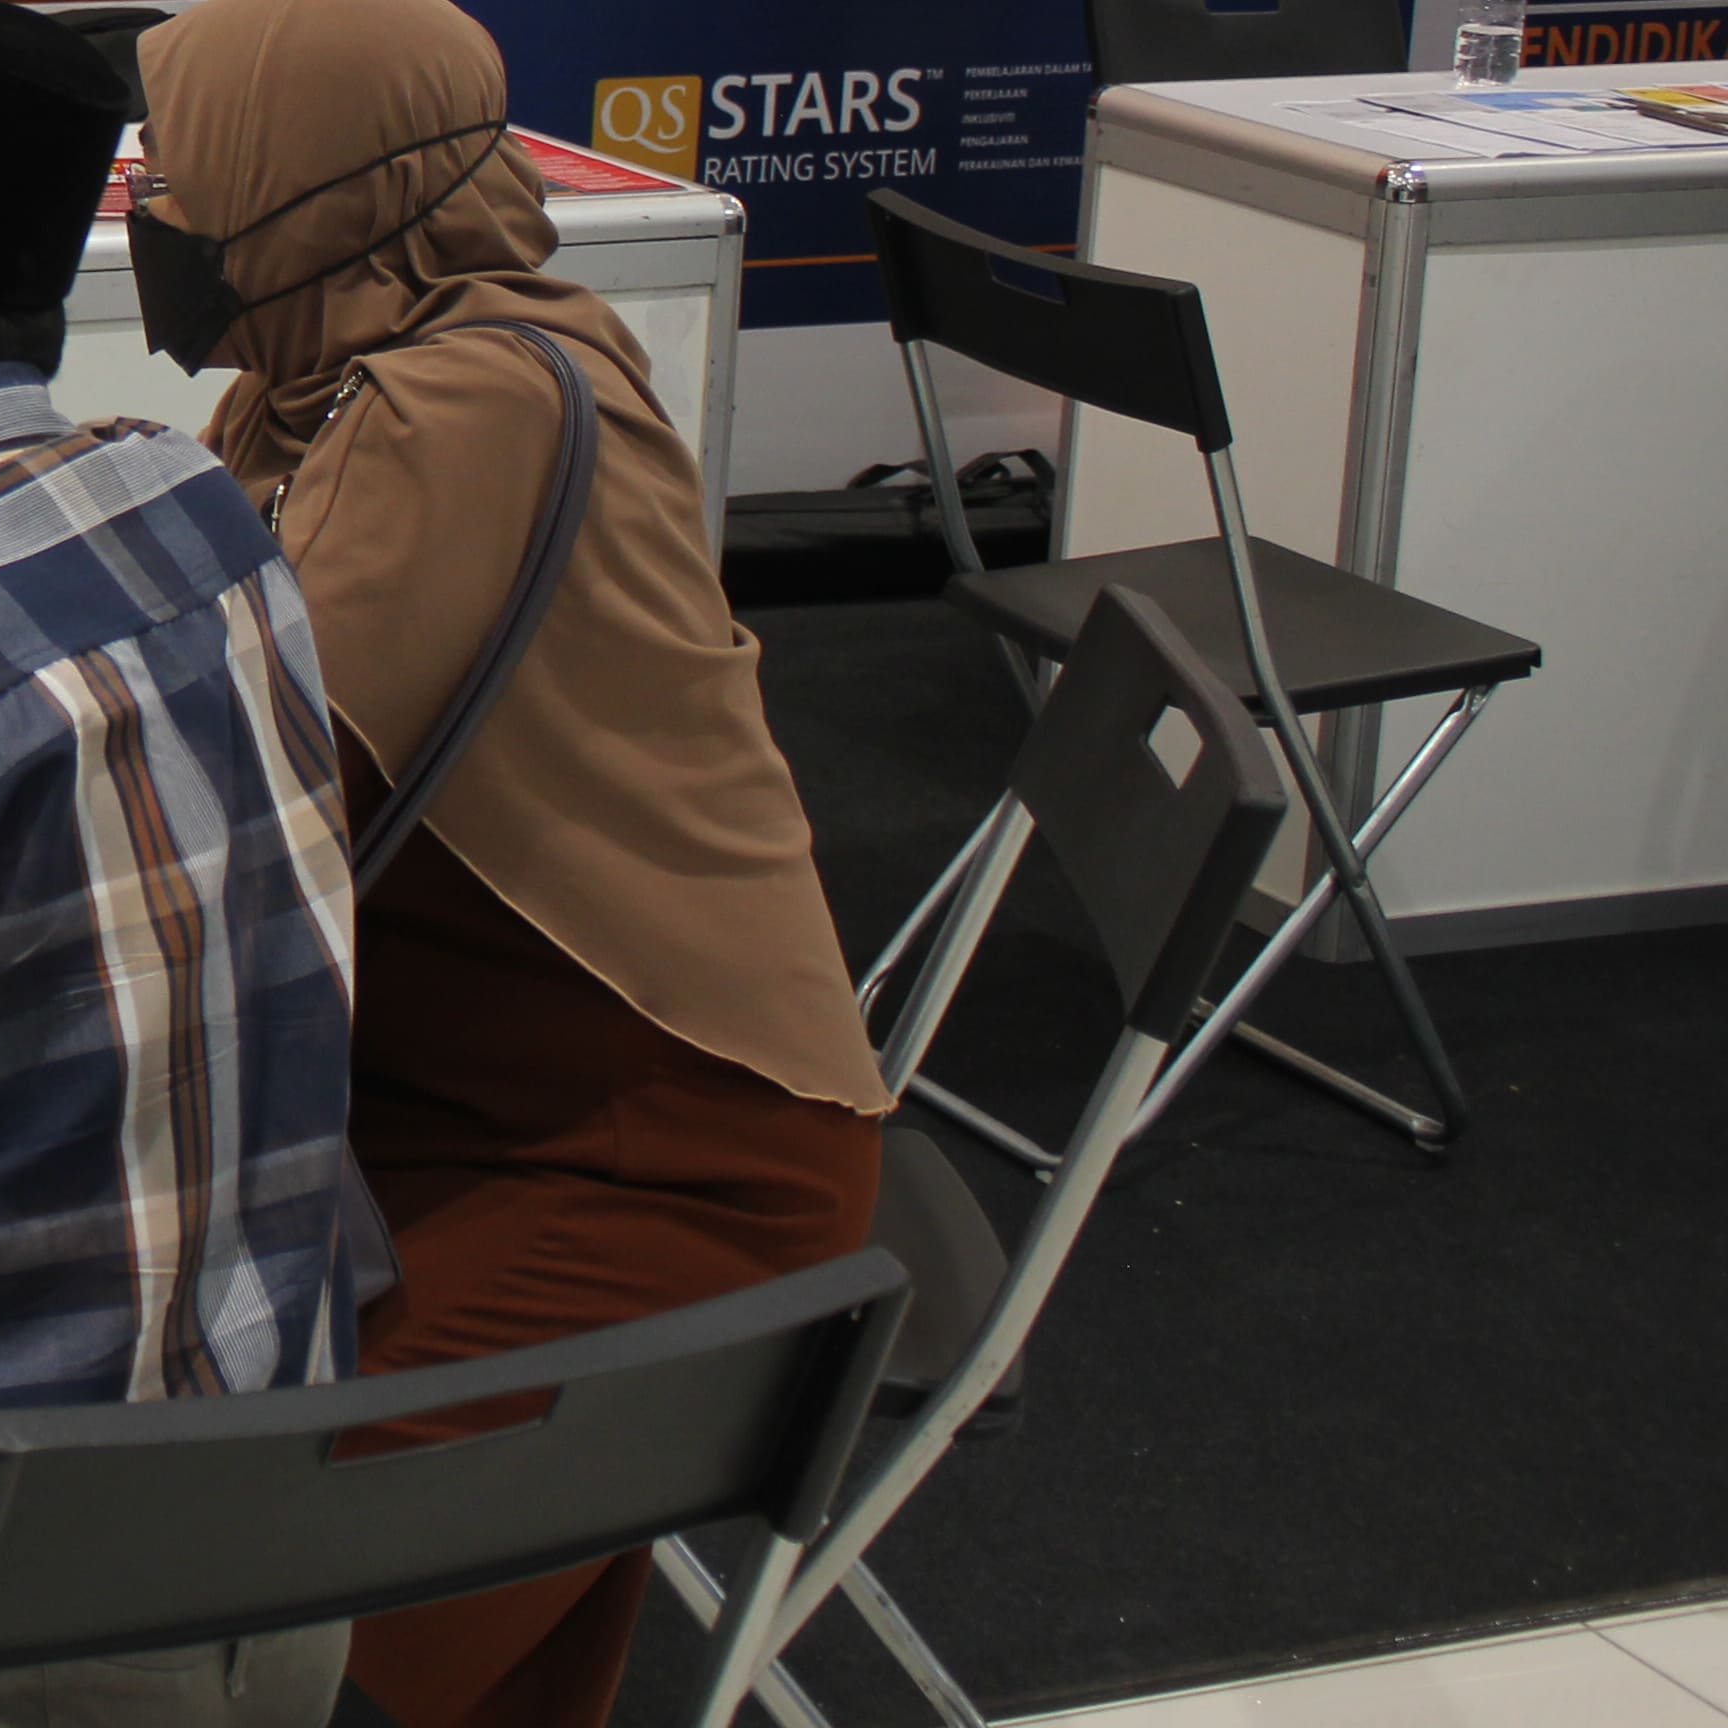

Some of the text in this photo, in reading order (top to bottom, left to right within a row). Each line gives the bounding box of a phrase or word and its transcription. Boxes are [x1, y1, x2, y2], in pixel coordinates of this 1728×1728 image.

[600, 67, 922, 153] QS STARS
[702, 147, 937, 185] RATING SYSTEM
